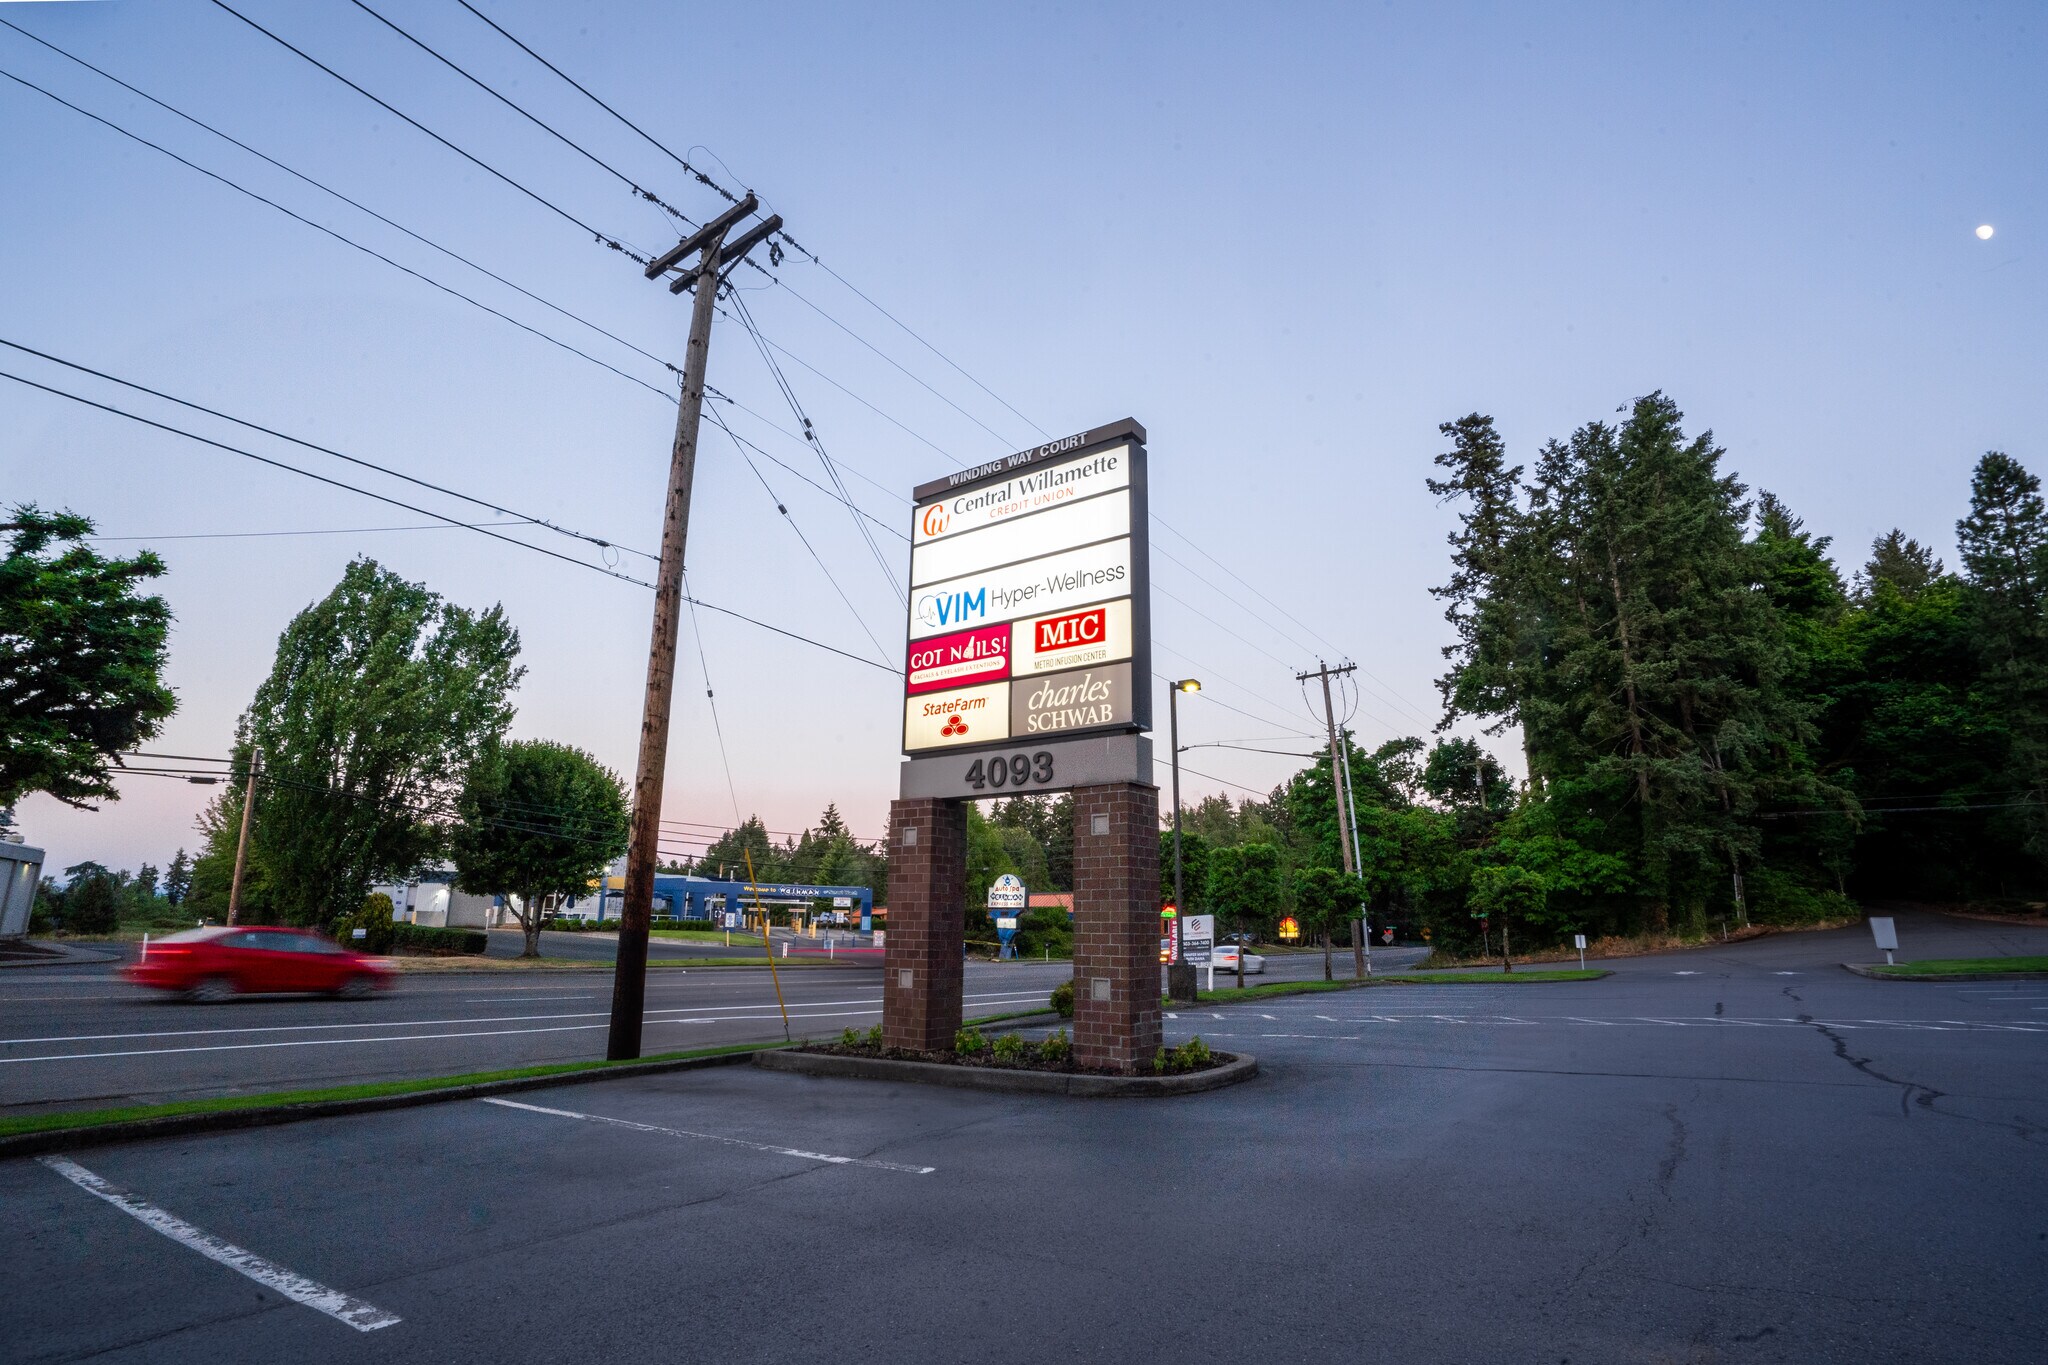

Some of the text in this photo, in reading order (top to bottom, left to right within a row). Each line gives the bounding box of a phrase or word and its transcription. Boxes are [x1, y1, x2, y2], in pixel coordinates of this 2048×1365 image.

[949, 432, 1088, 487] WINDING WAY COURT
[954, 455, 1118, 515] Central Willamette
[990, 487, 1075, 519] CREDIT UNION
[935, 565, 1125, 626] VIM Hyper-Wellness
[1040, 614, 1100, 648] MIC
[911, 648, 944, 669] GOT
[914, 671, 935, 681] FACIALS
[940, 667, 965, 676] EYELASH
[1034, 649, 1107, 669] METRO INFUSION CENTER
[1028, 673, 1112, 711] charles
[1027, 704, 1112, 733] SCHWAB
[964, 751, 1054, 789] 4093
